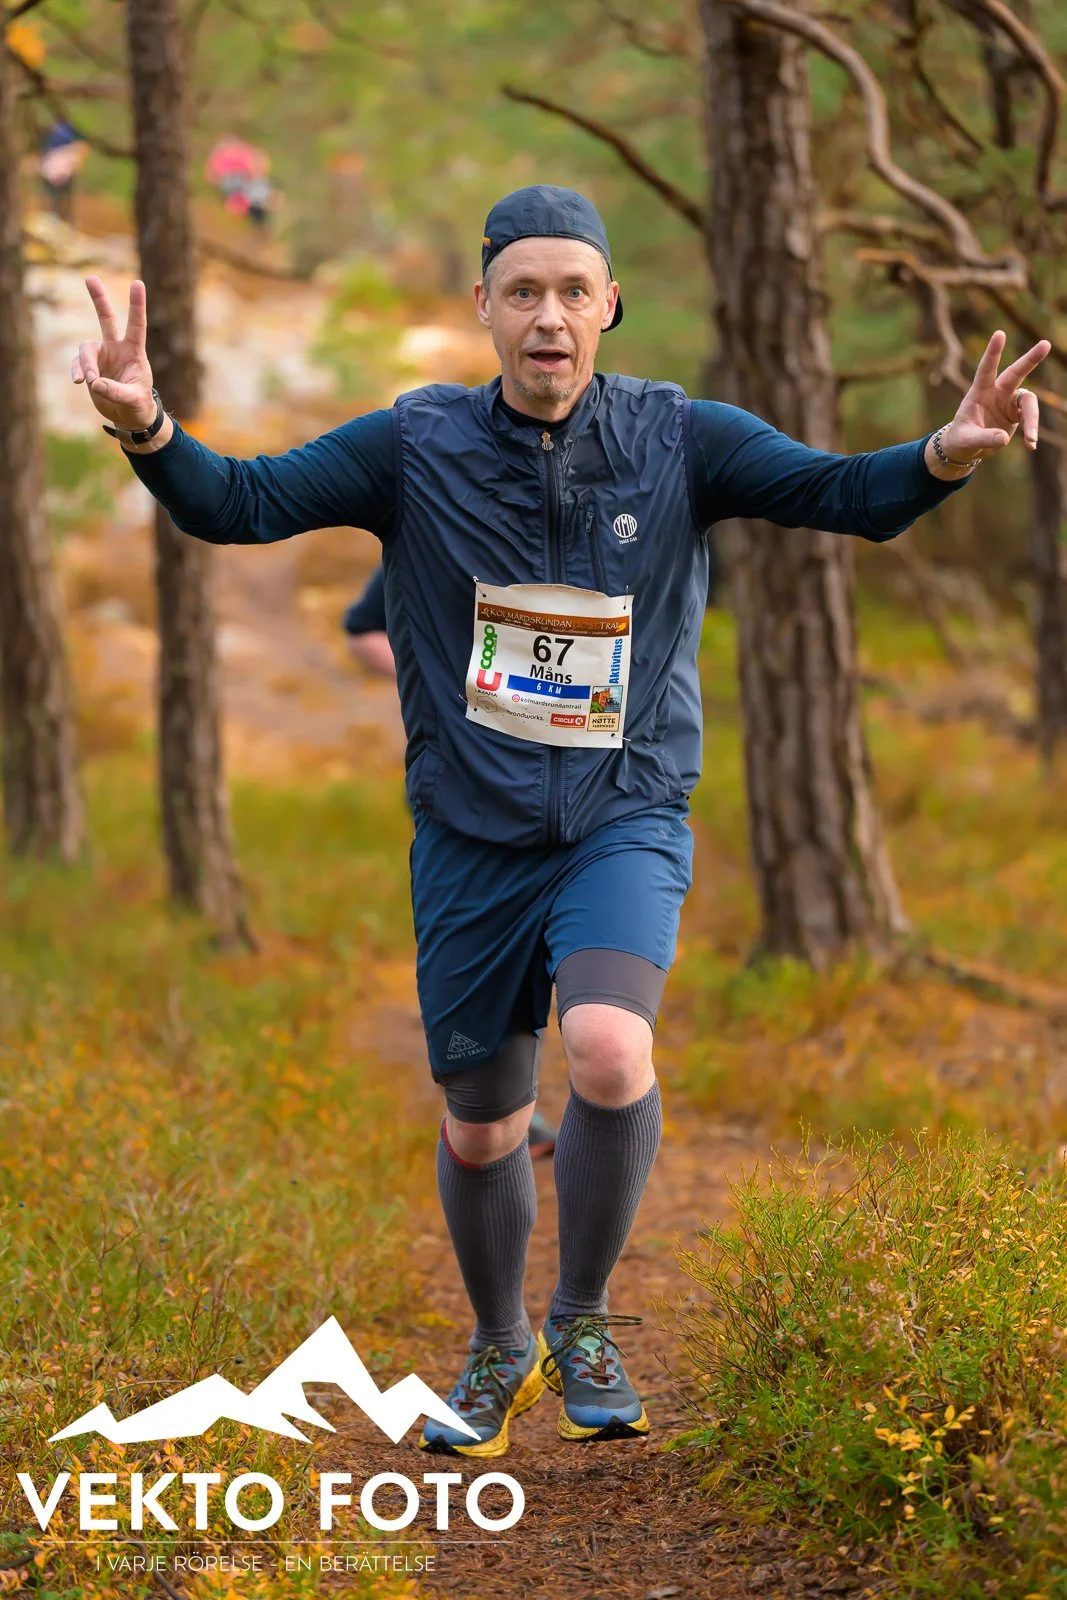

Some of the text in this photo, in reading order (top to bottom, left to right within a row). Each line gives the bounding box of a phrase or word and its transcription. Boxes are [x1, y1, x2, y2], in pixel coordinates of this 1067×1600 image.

[480, 624, 497, 669] coop
[533, 635, 574, 666] 67
[609, 638, 623, 684] Aktivitus
[530, 664, 572, 684] Måns
[536, 682, 562, 695] 6 KM
[520, 697, 582, 710] kolmardsrundantrail
[553, 716, 574, 724] CIRCLE
[467, 1046, 487, 1056] TRAIL
